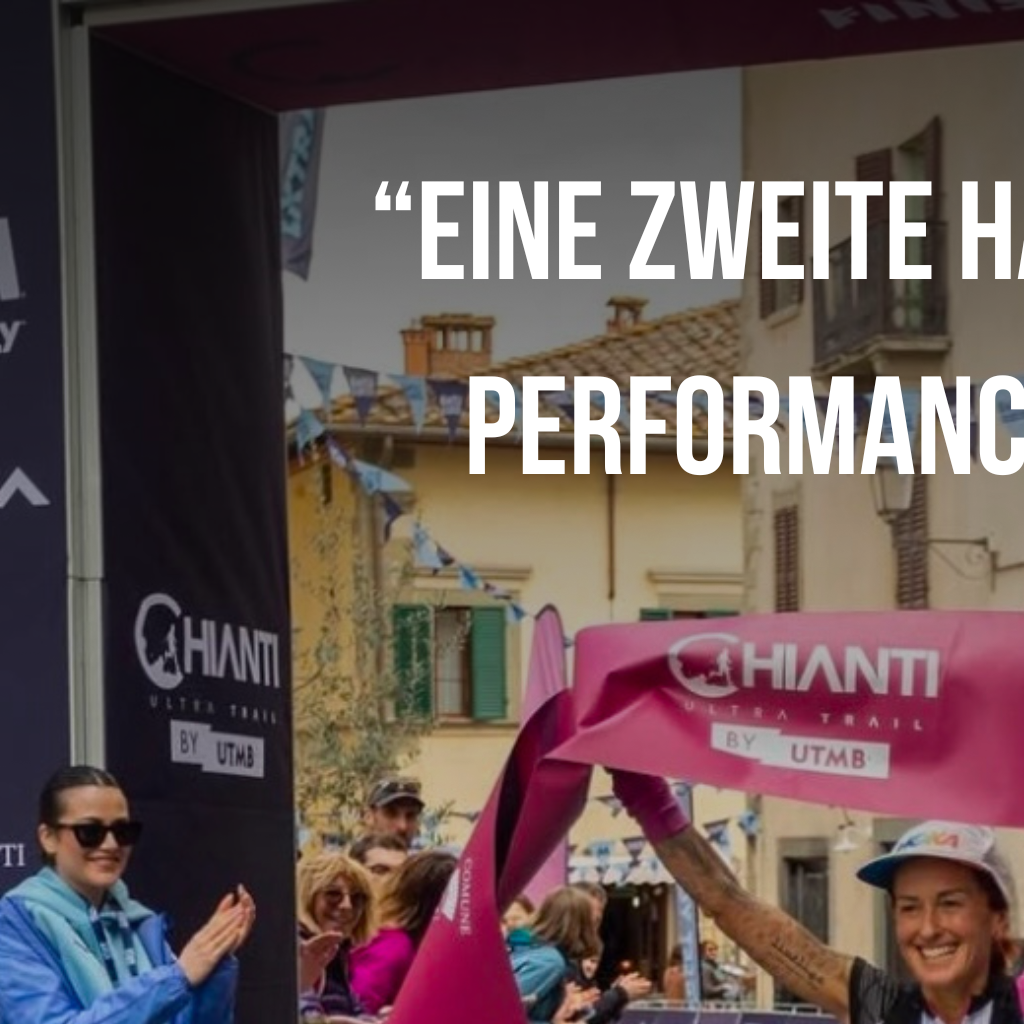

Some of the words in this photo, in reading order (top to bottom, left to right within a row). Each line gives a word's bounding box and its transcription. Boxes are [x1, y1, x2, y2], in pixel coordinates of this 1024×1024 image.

[135, 592, 281, 690] CHIANTI
[667, 632, 940, 698] CHIANTI
[684, 701, 789, 721] ULTRA
[819, 712, 923, 731] TRAIL
[180, 730, 199, 754] BY
[216, 741, 255, 769] UTMB
[725, 731, 757, 750] BY
[790, 743, 867, 770] UTMB
